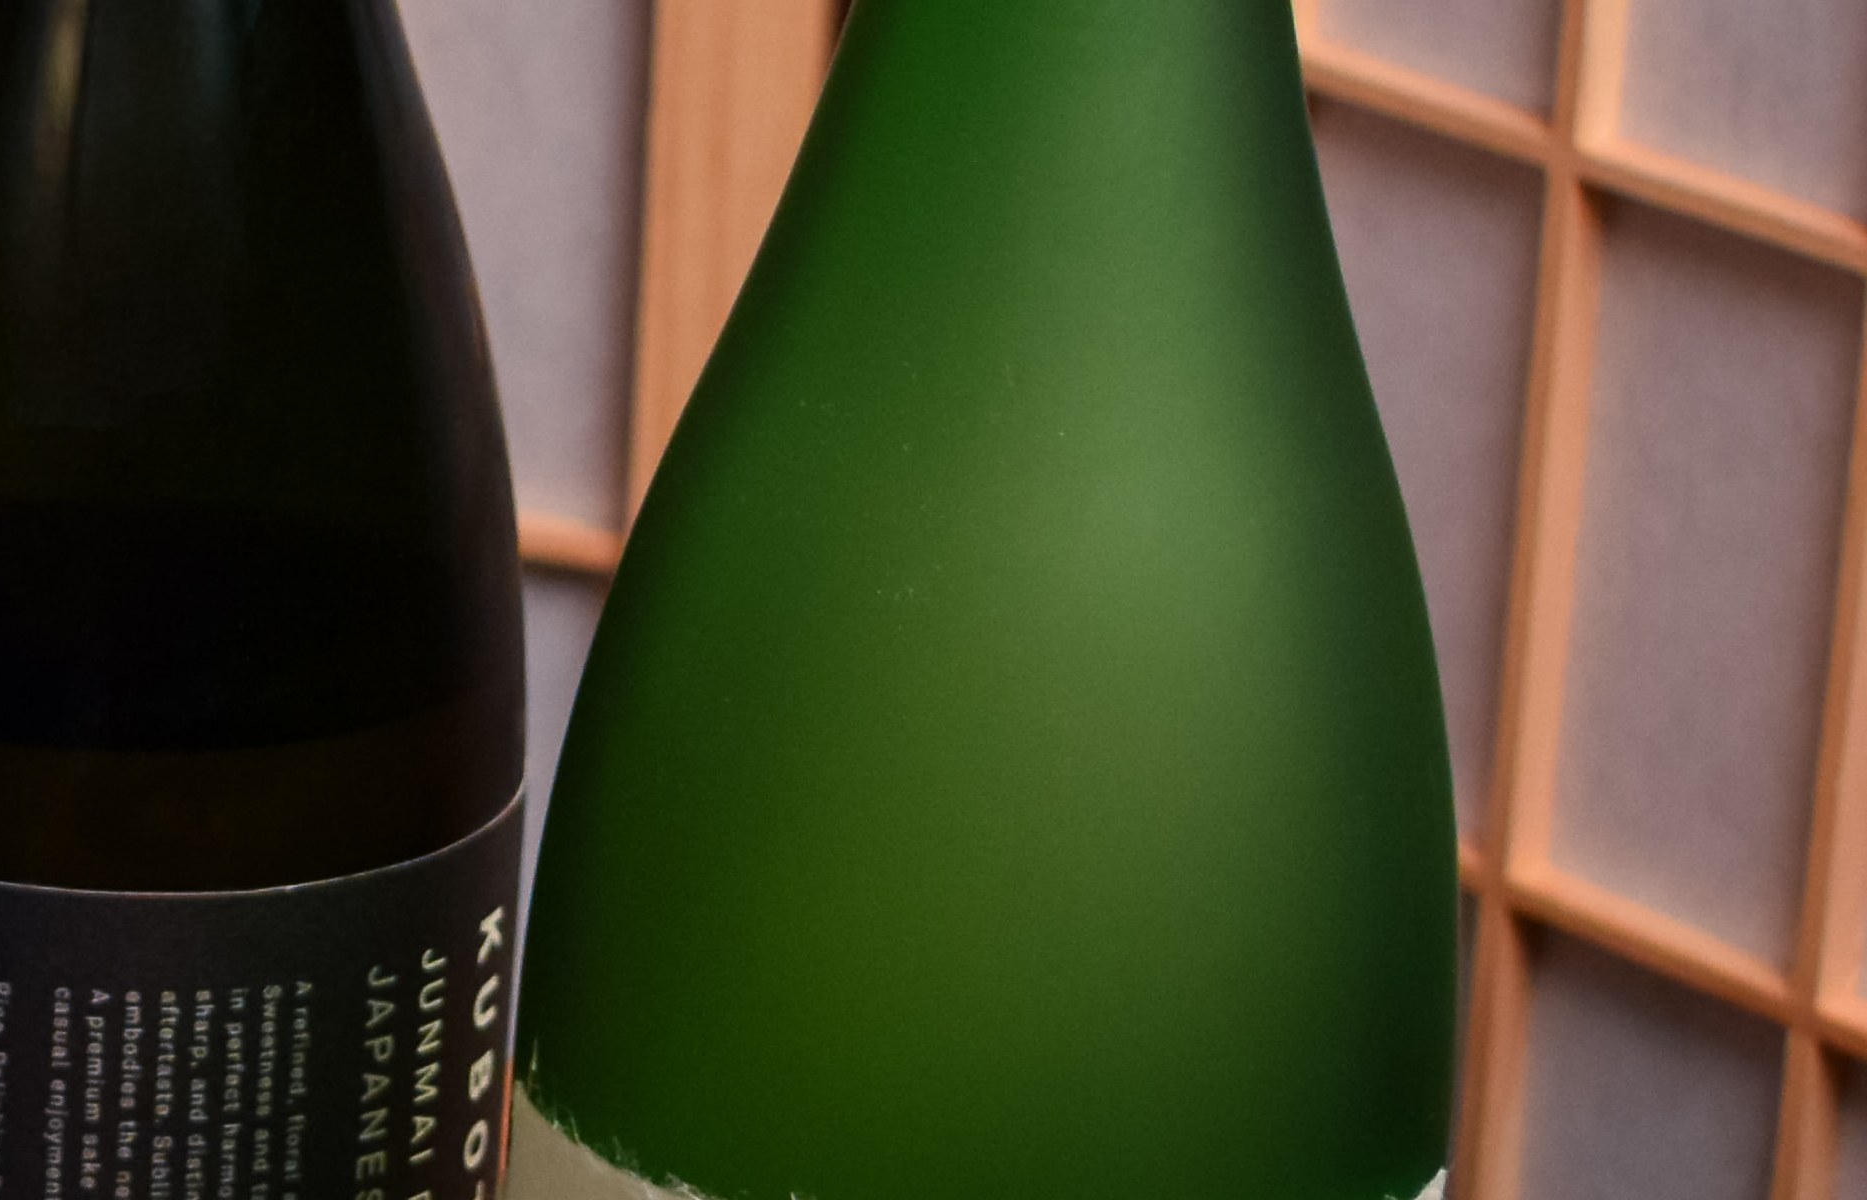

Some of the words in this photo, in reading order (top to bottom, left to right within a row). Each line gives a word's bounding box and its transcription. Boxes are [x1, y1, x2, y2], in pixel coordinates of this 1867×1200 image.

[89, 989, 109, 1004] A
[229, 987, 245, 1008] in
[294, 980, 312, 996] A
[49, 986, 74, 1068] casual
[119, 990, 142, 1109] embodies
[154, 989, 179, 1123] aftertaste.
[188, 989, 213, 1068] sharp,
[255, 984, 281, 1117] Sweetness
[408, 948, 446, 1168] JUNMAI
[83, 1015, 105, 1121] premium
[188, 1079, 207, 1120] and
[222, 1022, 244, 1111] perfect
[80, 1133, 101, 1189] sake
[116, 1121, 139, 1158] the
[251, 1129, 276, 1170] and
[285, 1115, 305, 1180] floral
